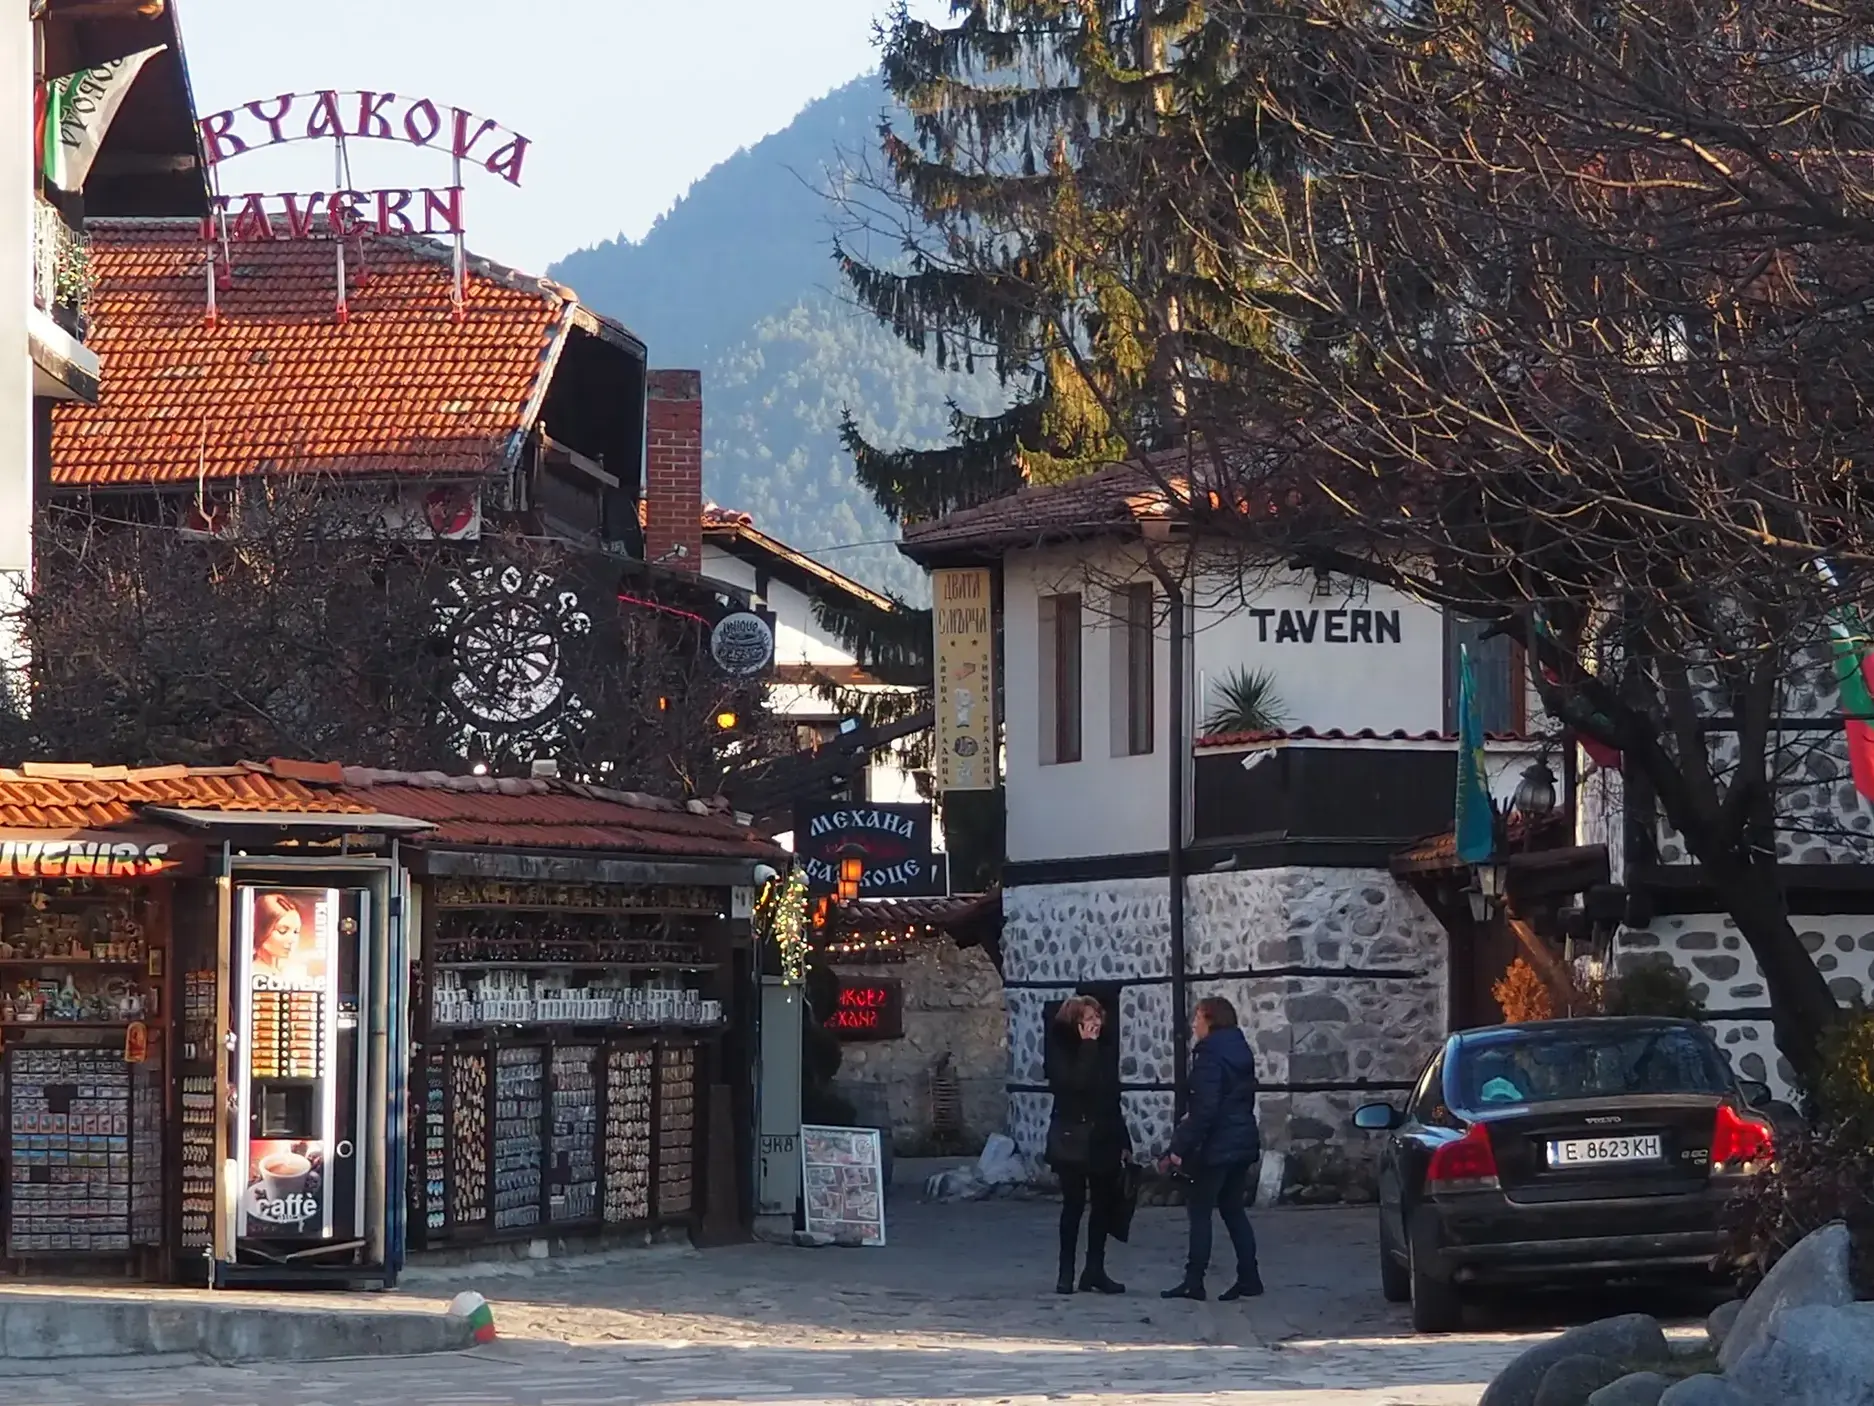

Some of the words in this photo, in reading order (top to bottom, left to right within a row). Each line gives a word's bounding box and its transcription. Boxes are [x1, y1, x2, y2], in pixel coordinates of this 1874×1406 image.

[198, 90, 532, 187] RYAKOVA
[199, 186, 465, 242] TAVERN
[1249, 609, 1402, 643] TAVERN
[810, 809, 914, 839] МЕХАНА
